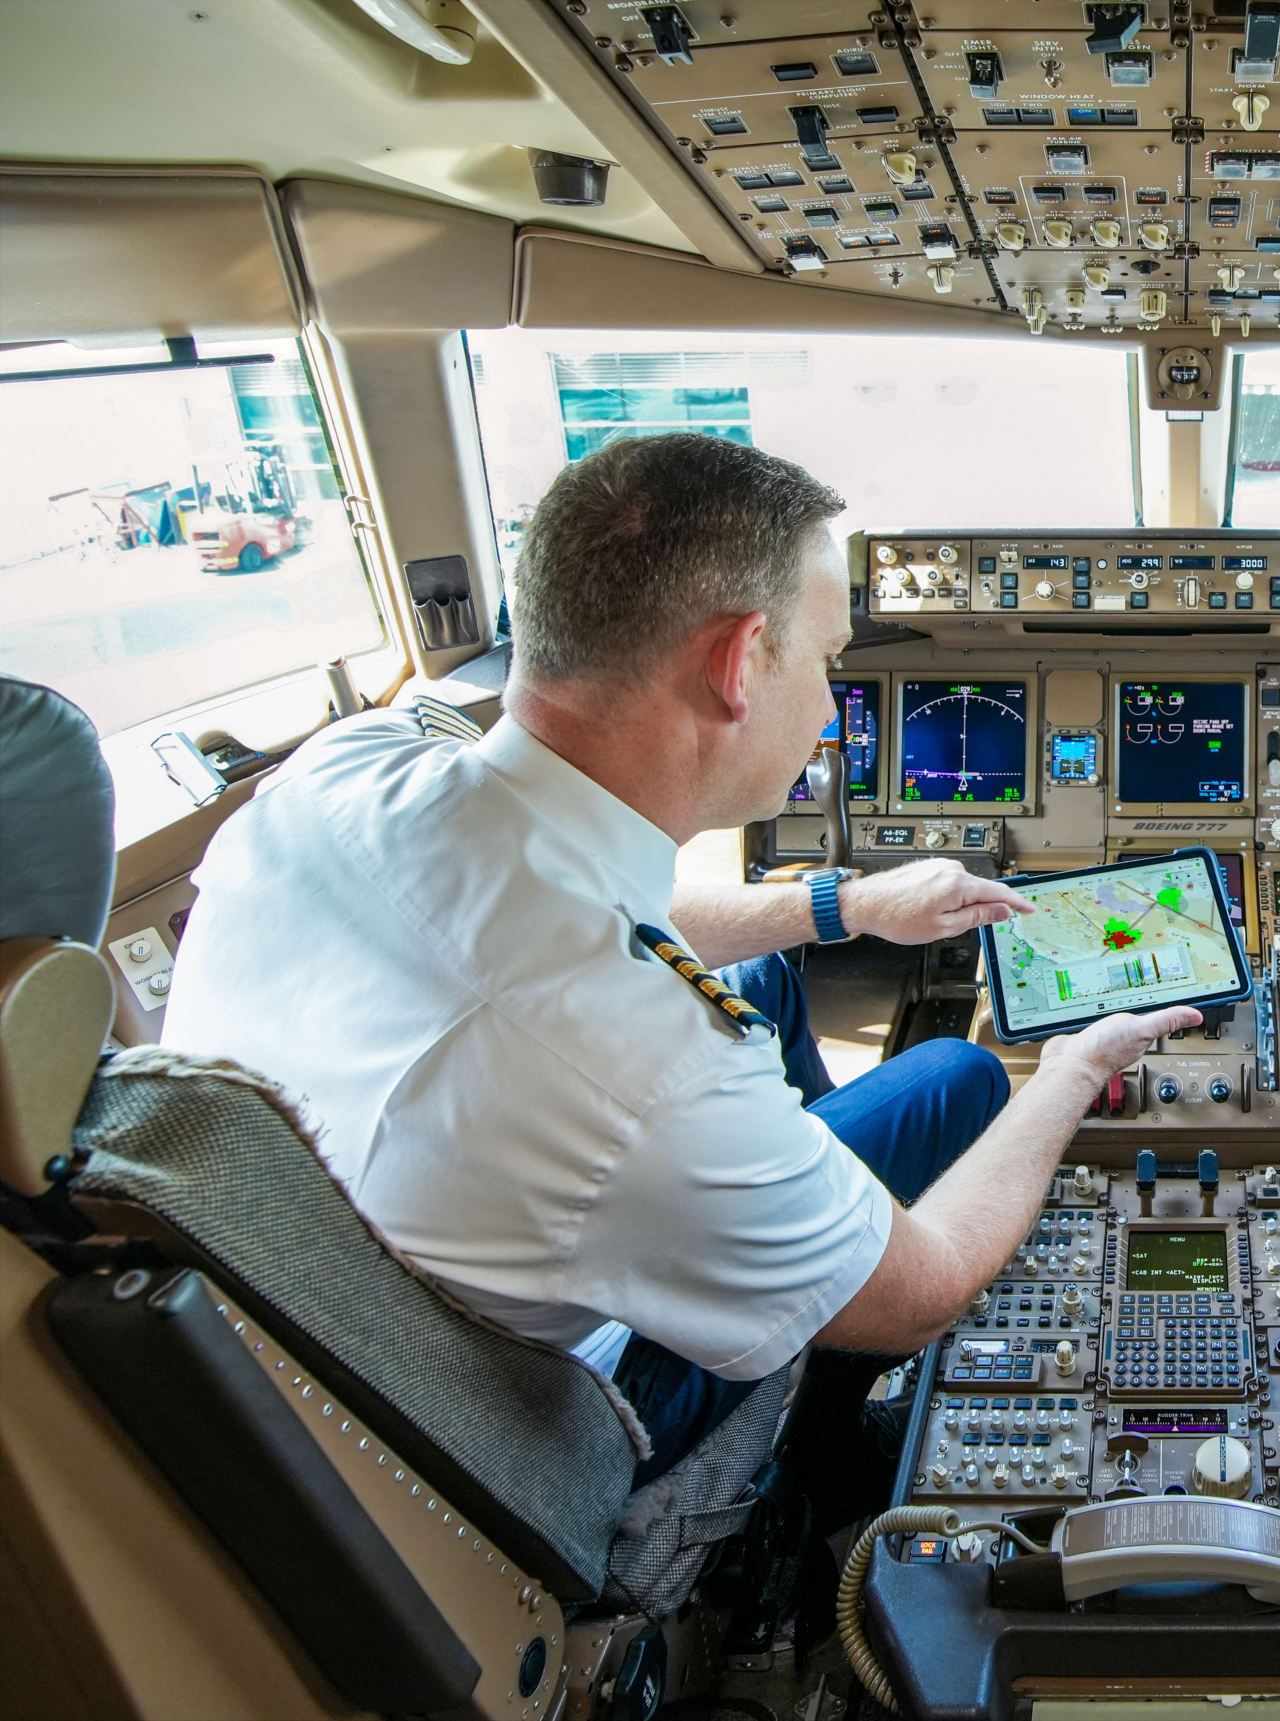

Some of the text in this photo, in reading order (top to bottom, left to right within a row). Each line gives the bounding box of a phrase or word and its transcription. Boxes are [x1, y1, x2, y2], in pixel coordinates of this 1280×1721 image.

[796, 89, 834, 97] PRIMARY
[809, 92, 859, 100] COMPUTERS
[692, 111, 716, 119] ASYM
[1050, 558, 1065, 567] 143
[1141, 558, 1159, 567] 299
[1240, 559, 1263, 568] 3000
[1132, 822, 1228, 831] BOEING 777
[124, 937, 145, 949] CHT
